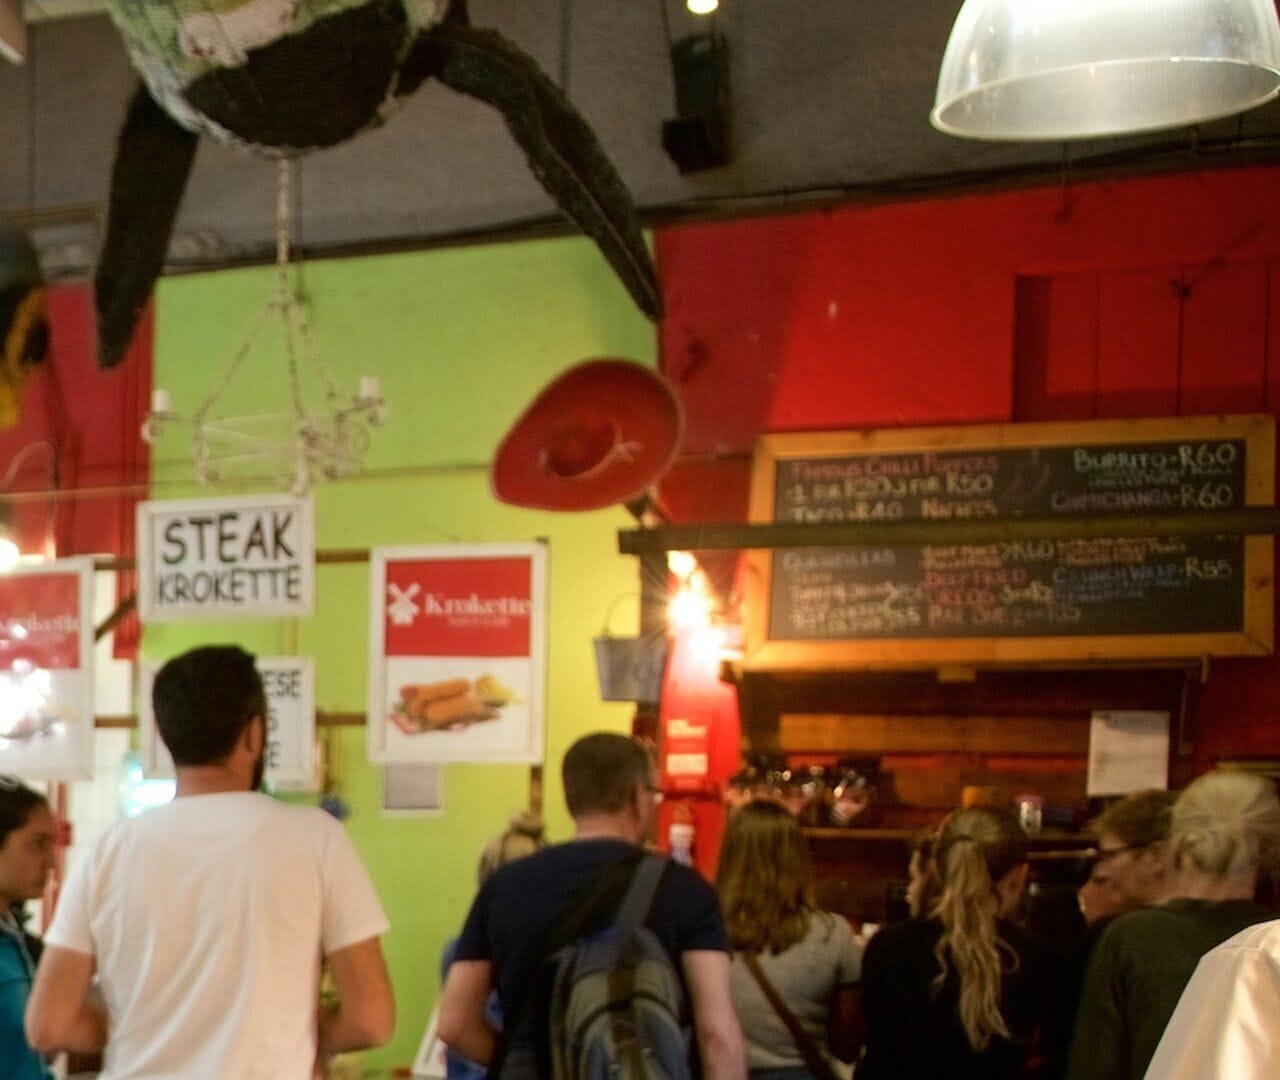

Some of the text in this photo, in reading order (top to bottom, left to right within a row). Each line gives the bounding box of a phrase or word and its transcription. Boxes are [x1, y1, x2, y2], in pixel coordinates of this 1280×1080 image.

[1073, 449, 1167, 472] BURRITO
[1179, 443, 1236, 467] R60
[1181, 481, 1234, 509] R60
[162, 510, 295, 566] STEAK
[157, 566, 302, 605] KROKETTE
